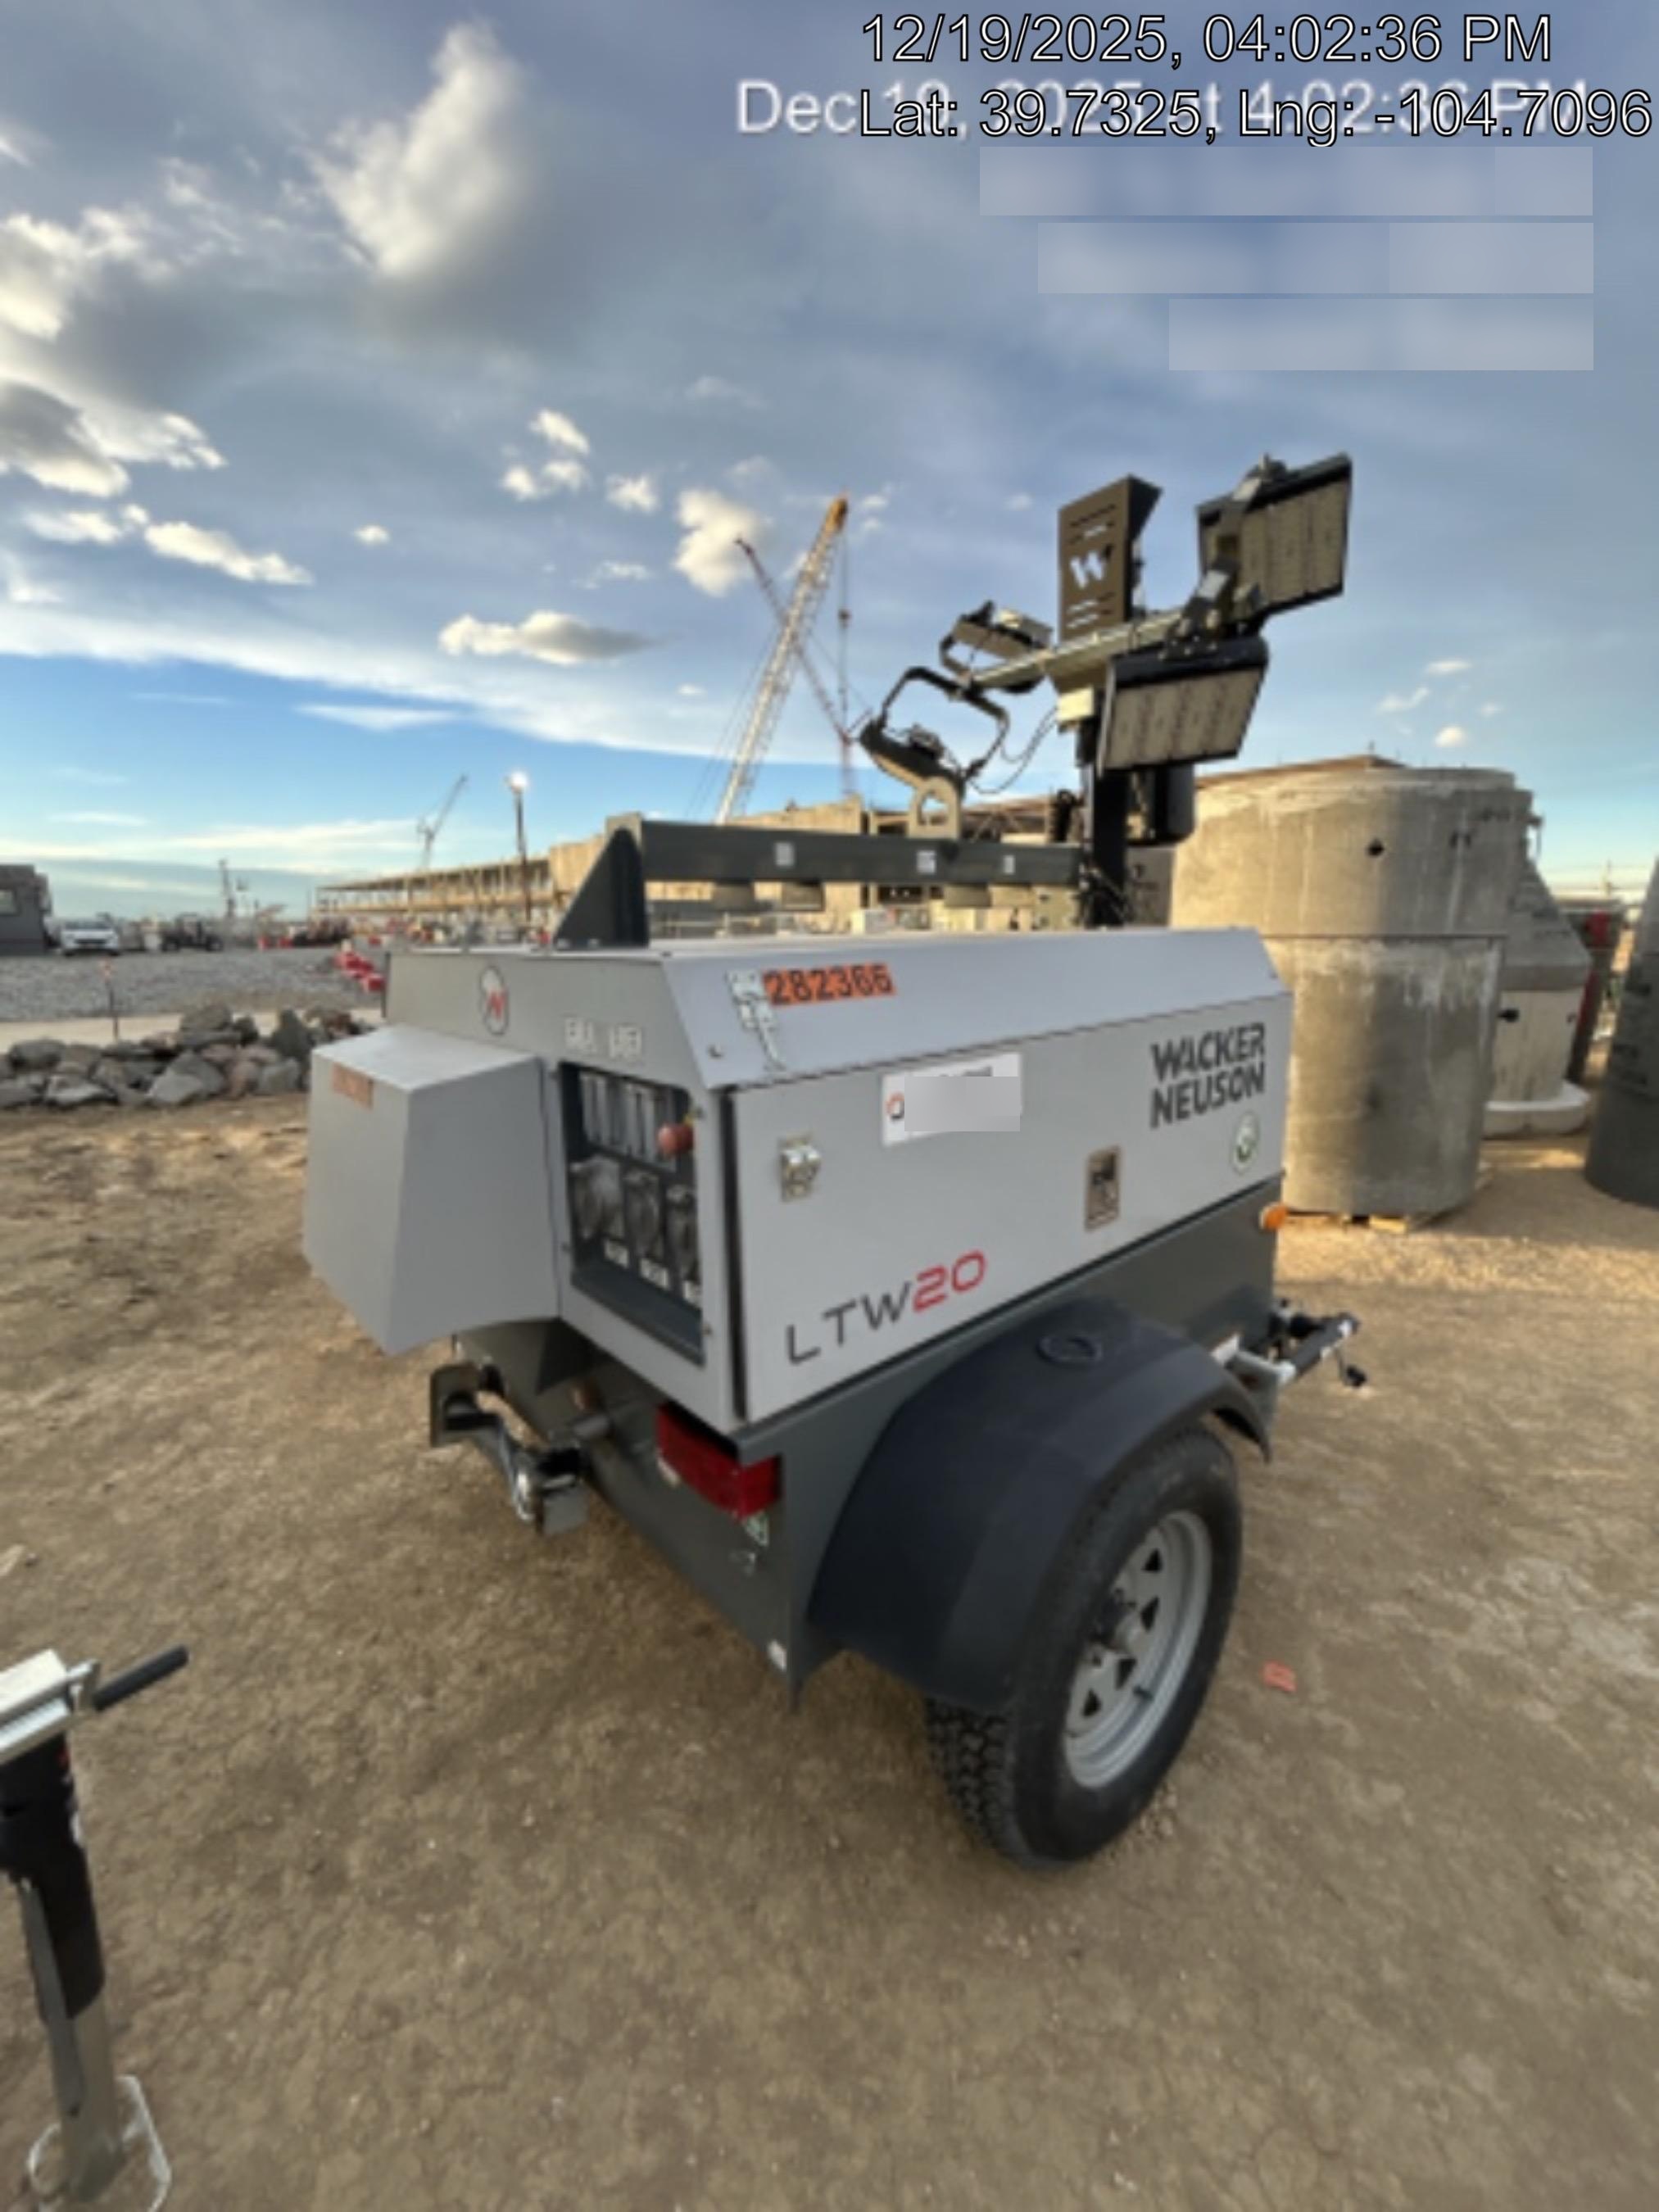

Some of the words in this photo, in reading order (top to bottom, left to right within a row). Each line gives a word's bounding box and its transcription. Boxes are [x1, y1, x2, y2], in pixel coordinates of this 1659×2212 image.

[764, 963, 894, 1006] 282366
[1150, 1022, 1266, 1082] WACKER
[1150, 1062, 1266, 1129] NEUSON
[786, 1250, 987, 1365] LTW20
